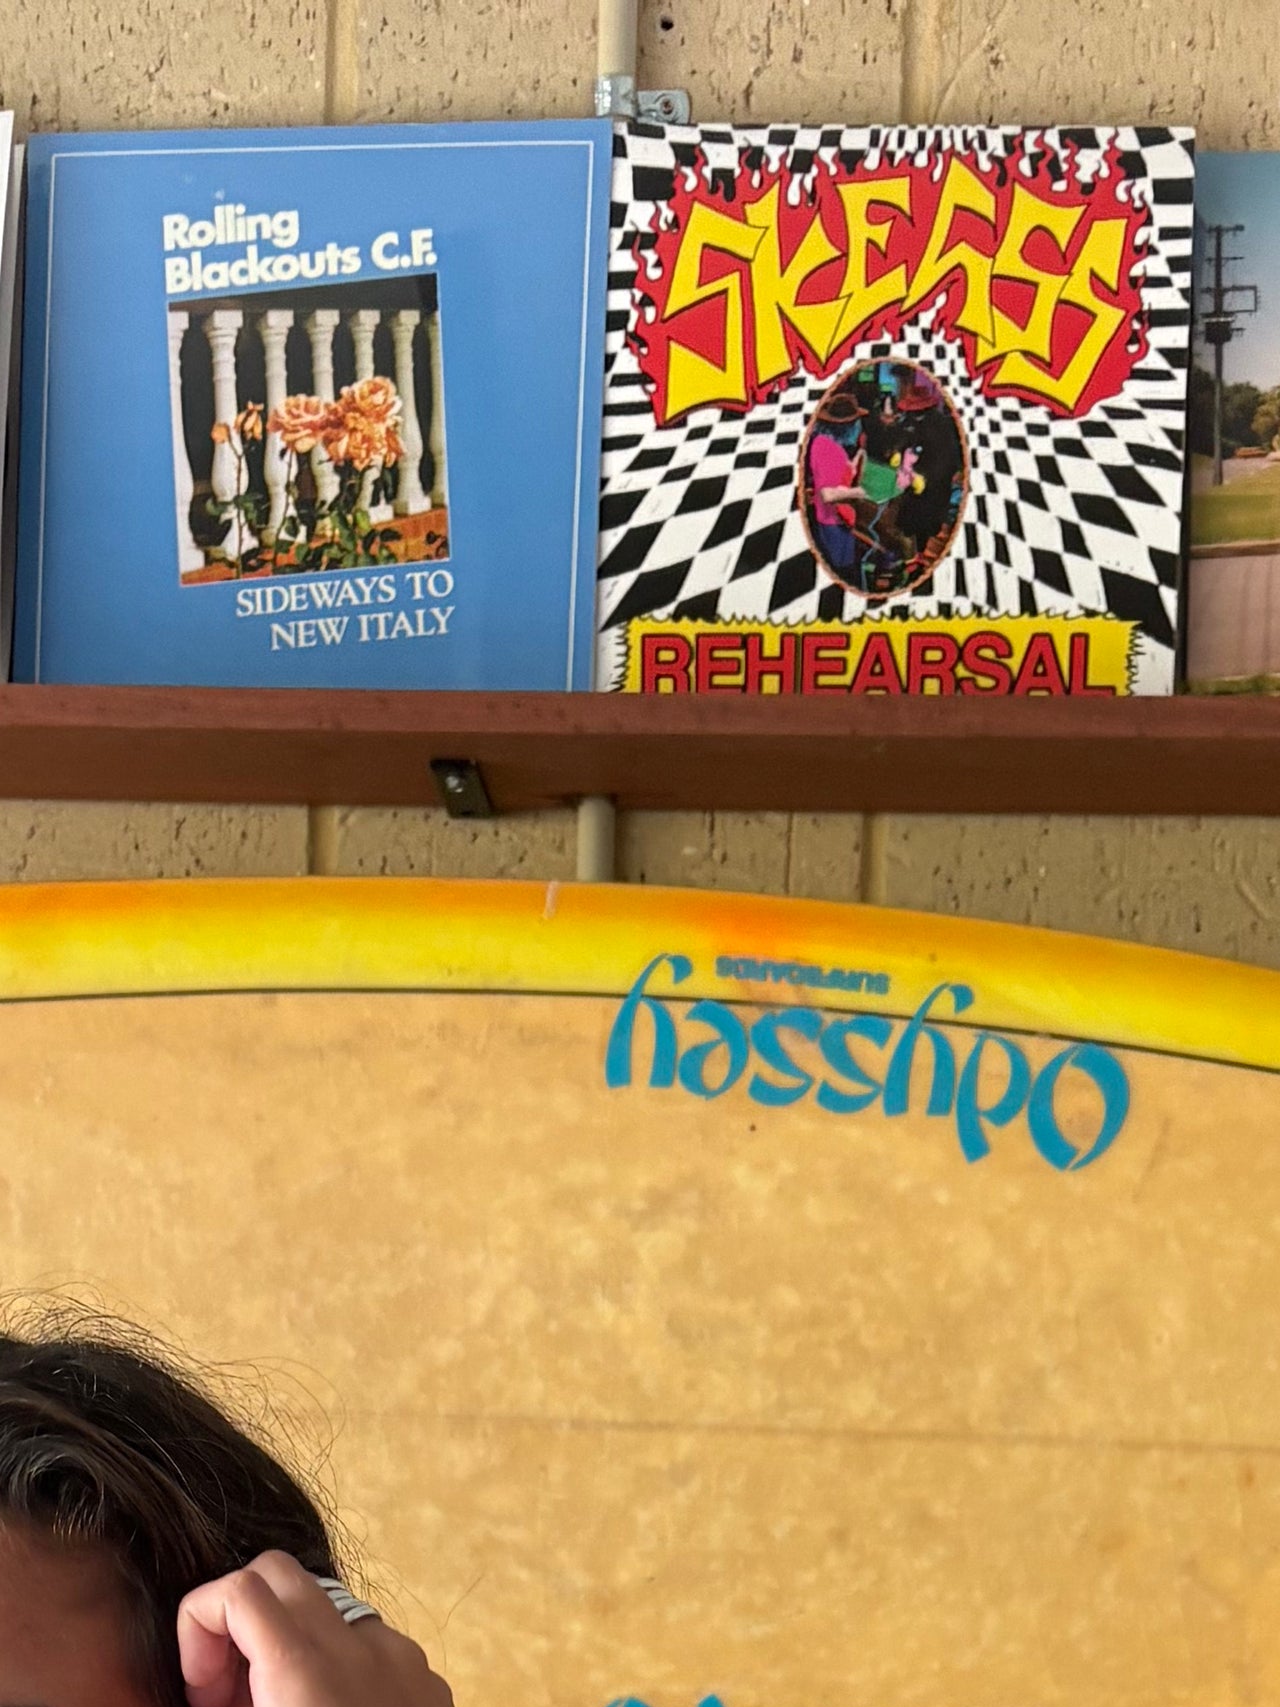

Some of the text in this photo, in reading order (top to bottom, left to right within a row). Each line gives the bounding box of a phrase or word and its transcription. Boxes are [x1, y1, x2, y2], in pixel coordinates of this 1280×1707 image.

[162, 203, 299, 251] Rolling
[164, 229, 437, 294] Blackouts C.F.
[235, 569, 454, 618] SIDEWAYS TO
[270, 606, 455, 651] NEW ITALY
[639, 633, 1116, 695] REHEARSAL
[605, 953, 1130, 1172] Odyssey
